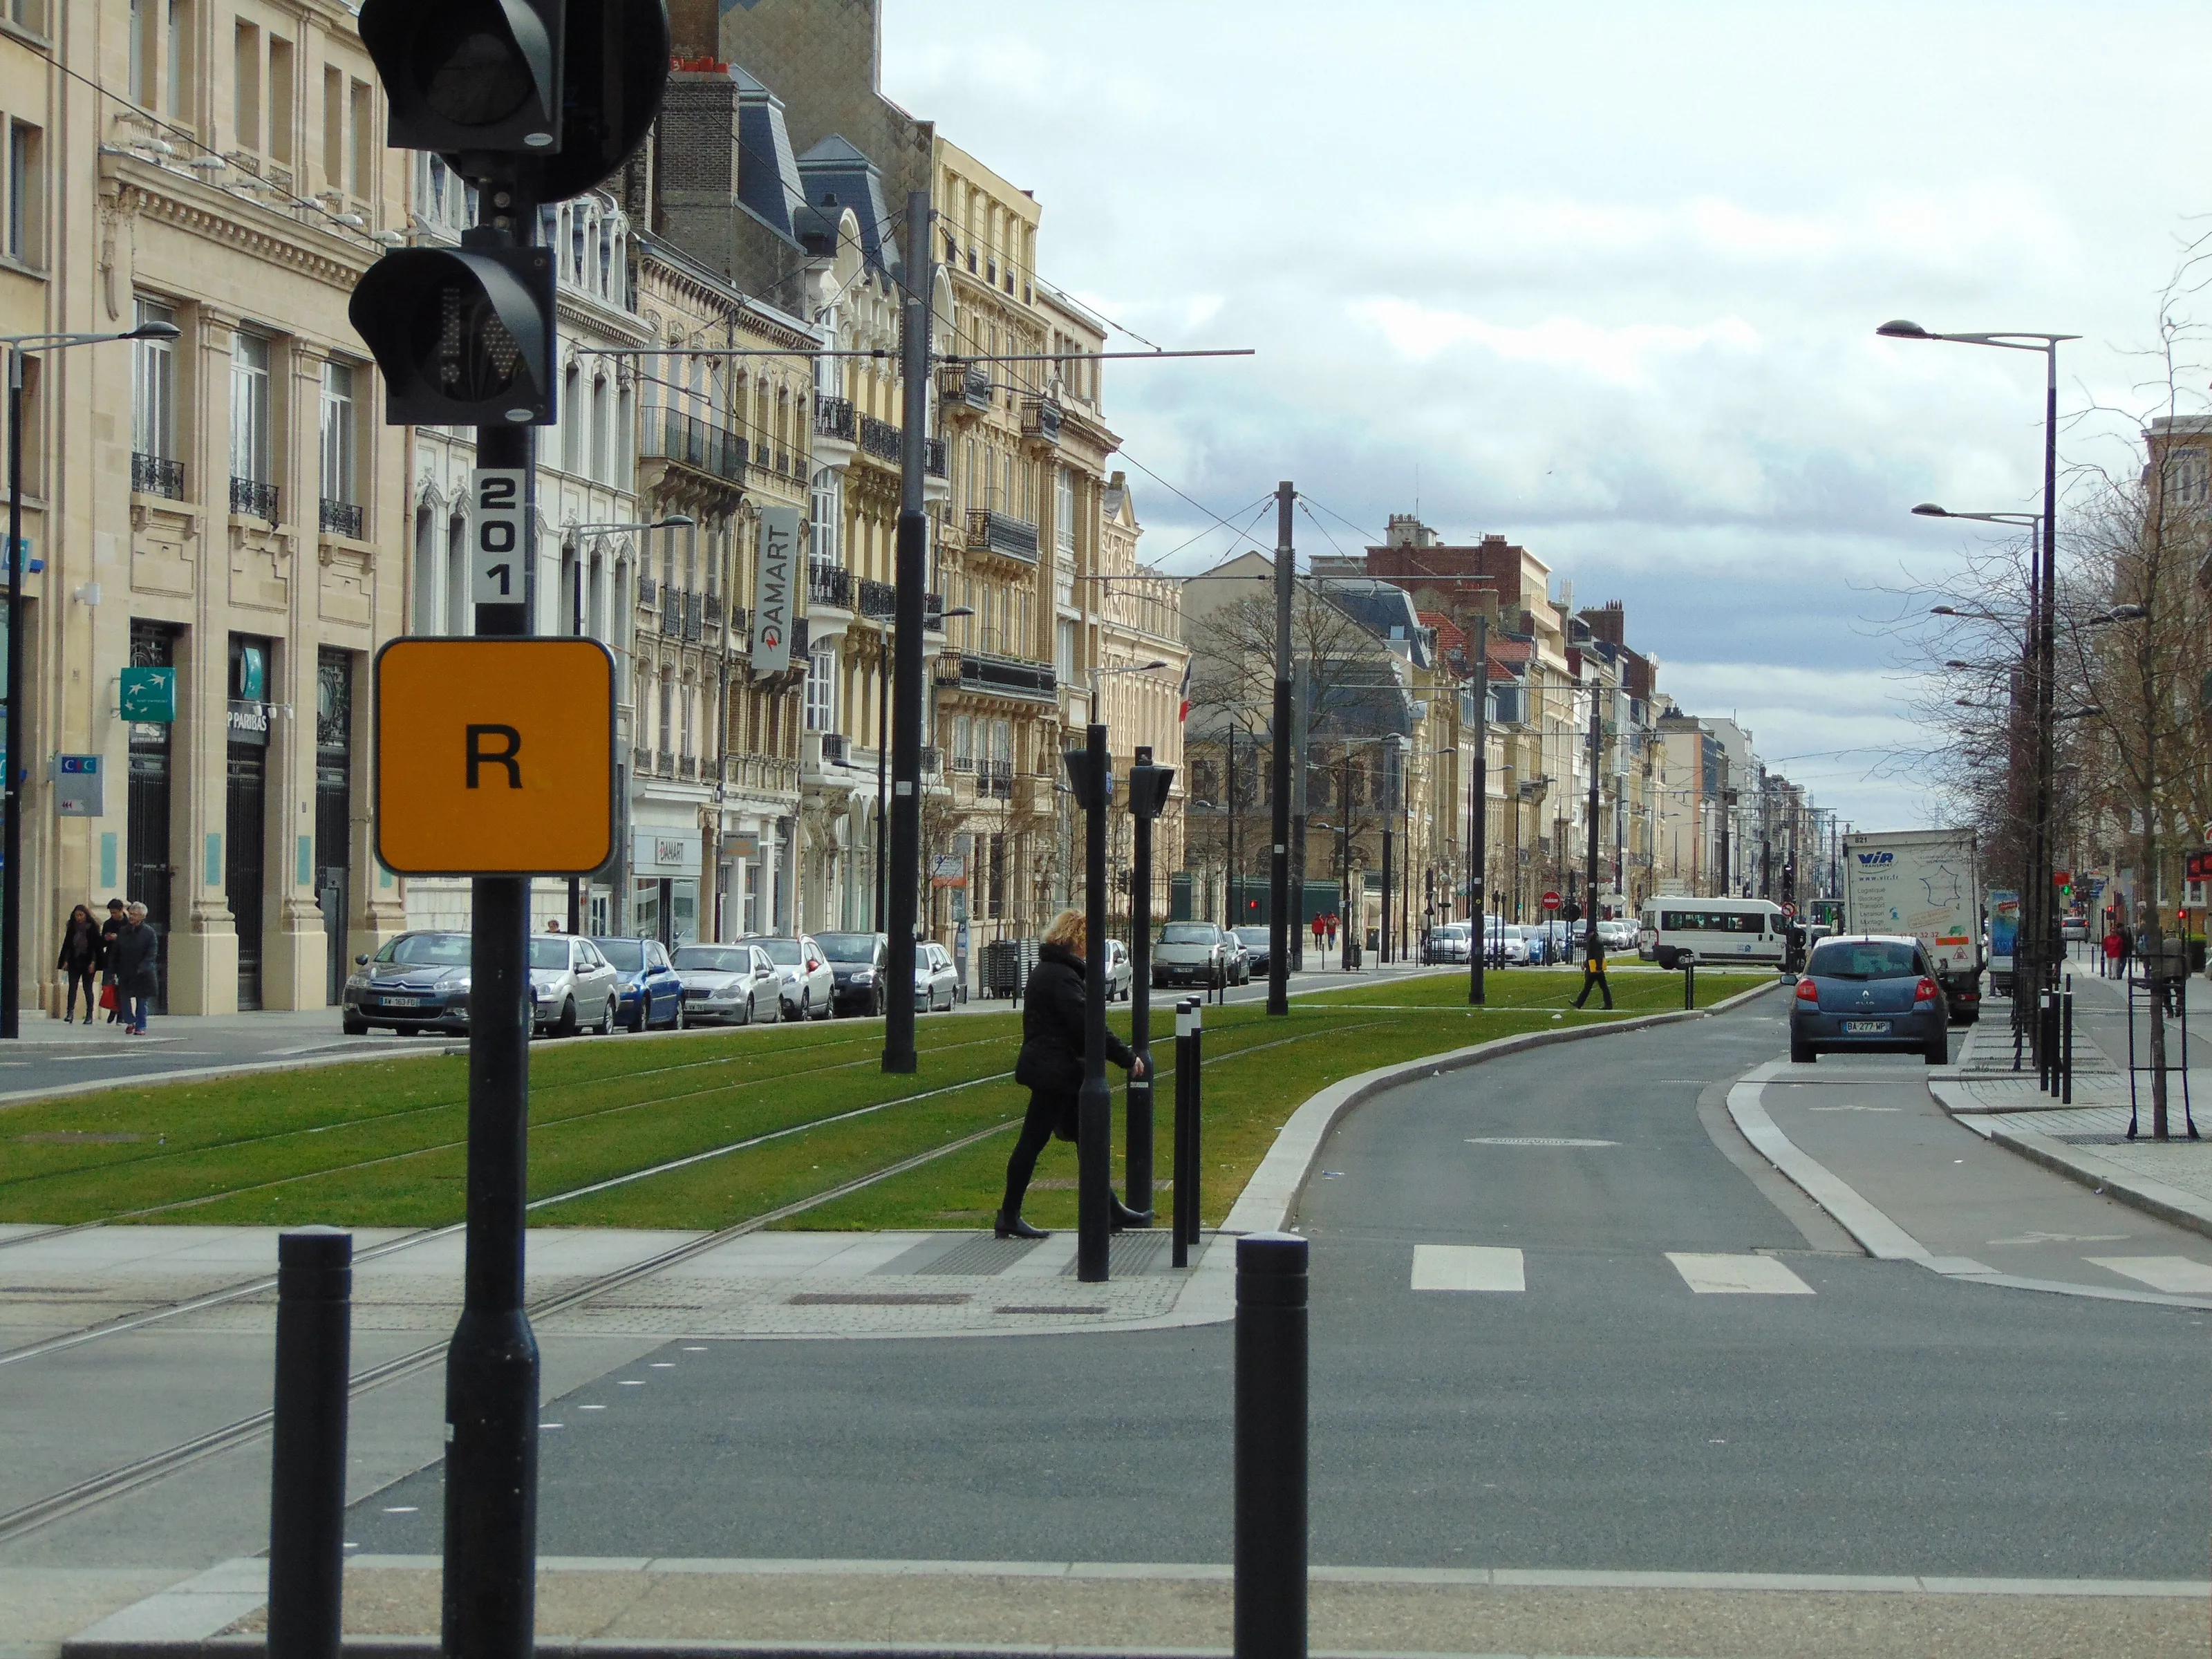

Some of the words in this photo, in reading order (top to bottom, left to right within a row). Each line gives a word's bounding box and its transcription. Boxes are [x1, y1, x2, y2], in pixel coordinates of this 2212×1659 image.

[480, 477, 516, 595] 201
[761, 524, 789, 650] DAMART
[234, 712, 267, 731] PARIBAS
[64, 760, 93, 771] CIC
[465, 724, 523, 789] R
[659, 841, 684, 861] DAMART
